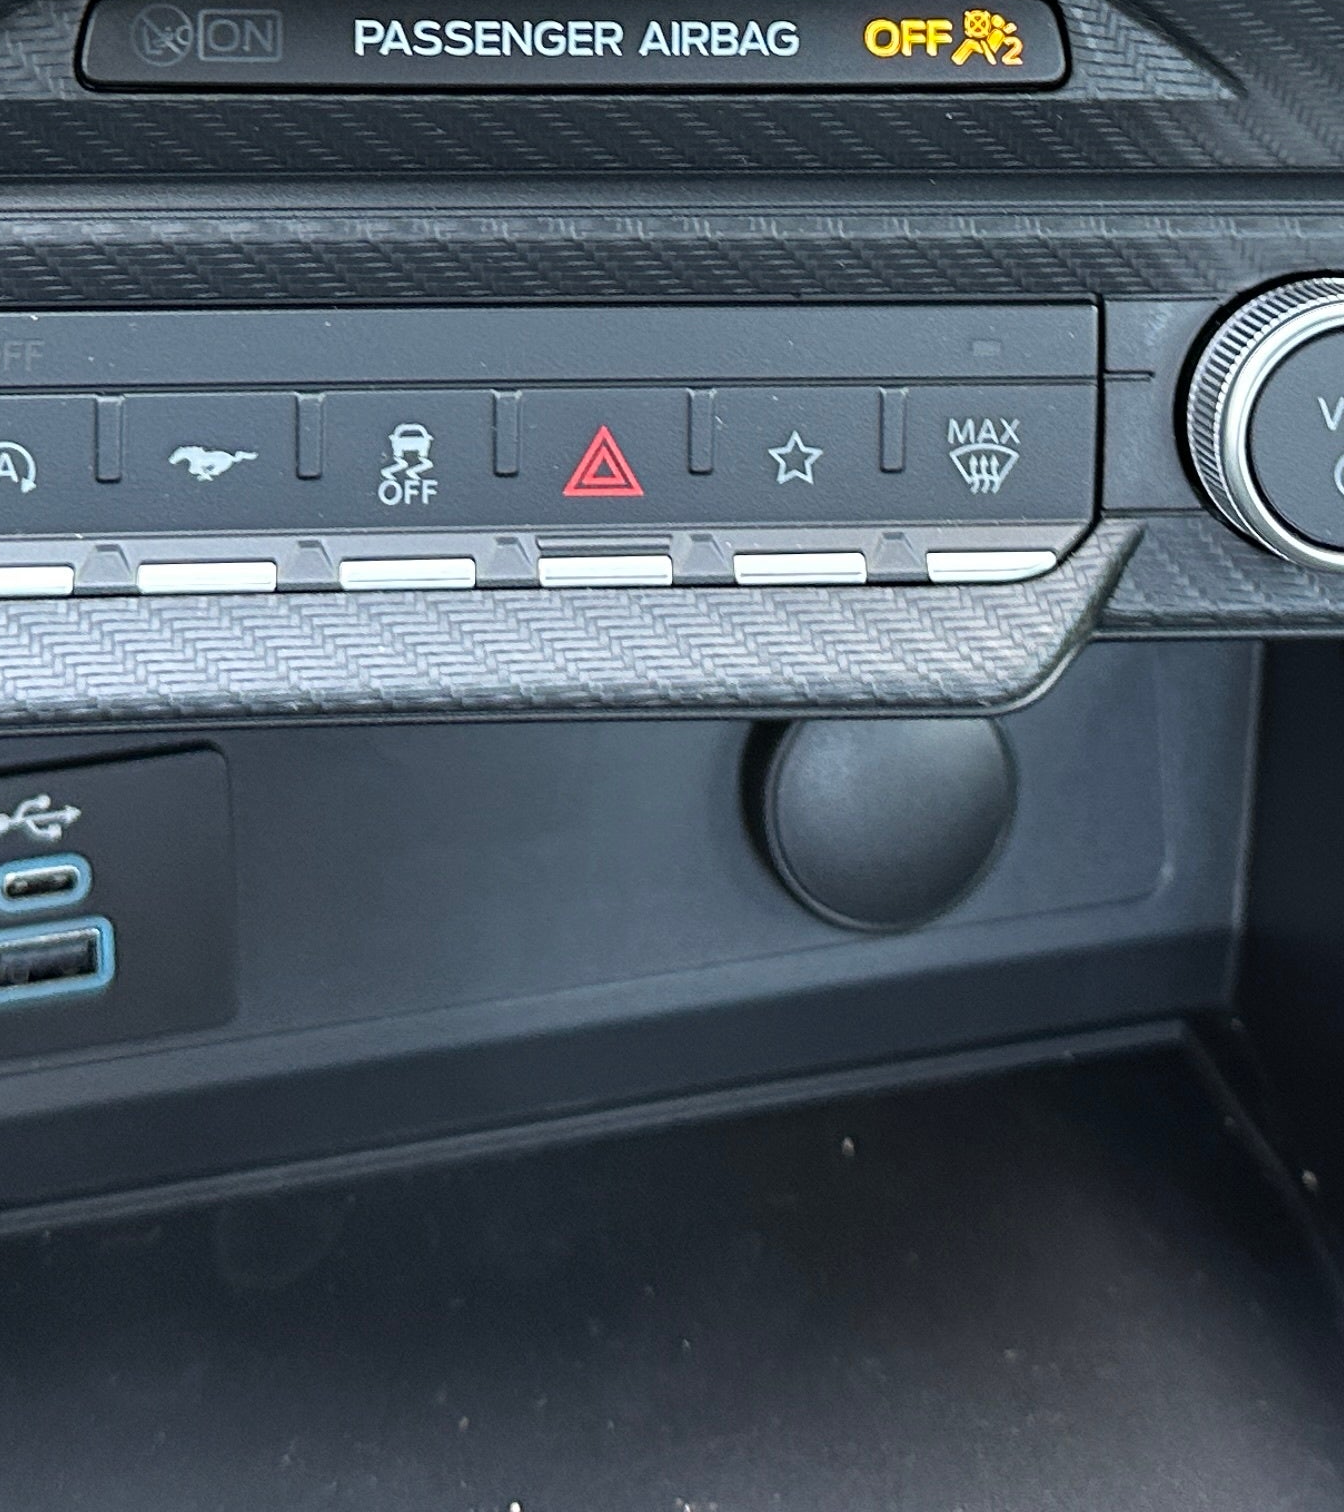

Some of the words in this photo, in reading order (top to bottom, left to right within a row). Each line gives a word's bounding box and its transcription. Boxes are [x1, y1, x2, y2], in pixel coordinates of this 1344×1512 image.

[206, 18, 274, 53] ON
[353, 18, 625, 58] PASSENGER
[637, 19, 801, 58] AIRBAG
[863, 17, 954, 58] OFF
[946, 417, 1021, 445] MAX
[377, 479, 439, 506] OFF
